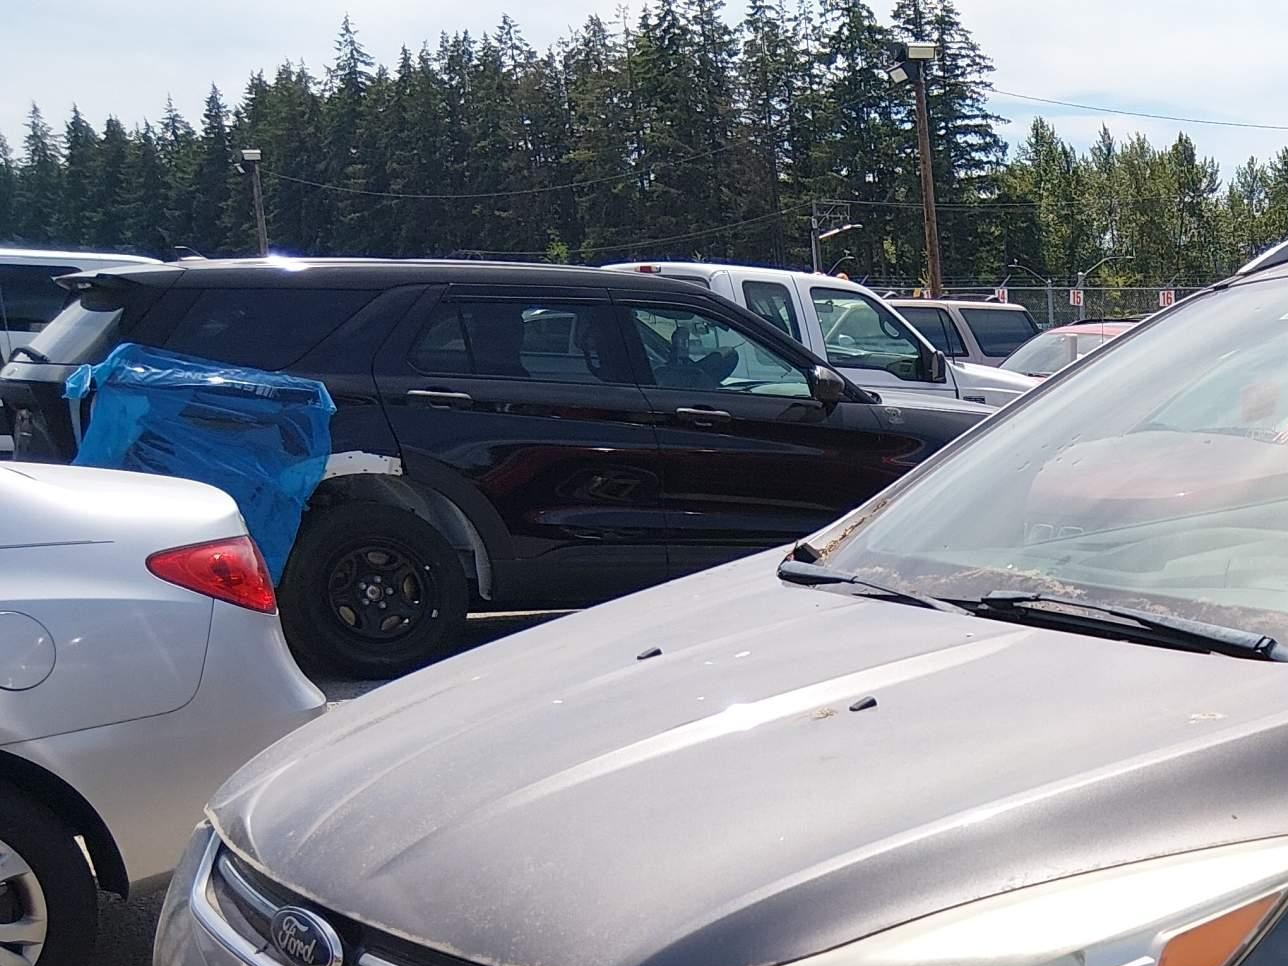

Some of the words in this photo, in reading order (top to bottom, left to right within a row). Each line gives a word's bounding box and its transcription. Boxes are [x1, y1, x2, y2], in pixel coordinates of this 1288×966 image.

[1071, 291, 1082, 305] 15
[1161, 291, 1173, 306] 16
[278, 915, 318, 965] Ford
